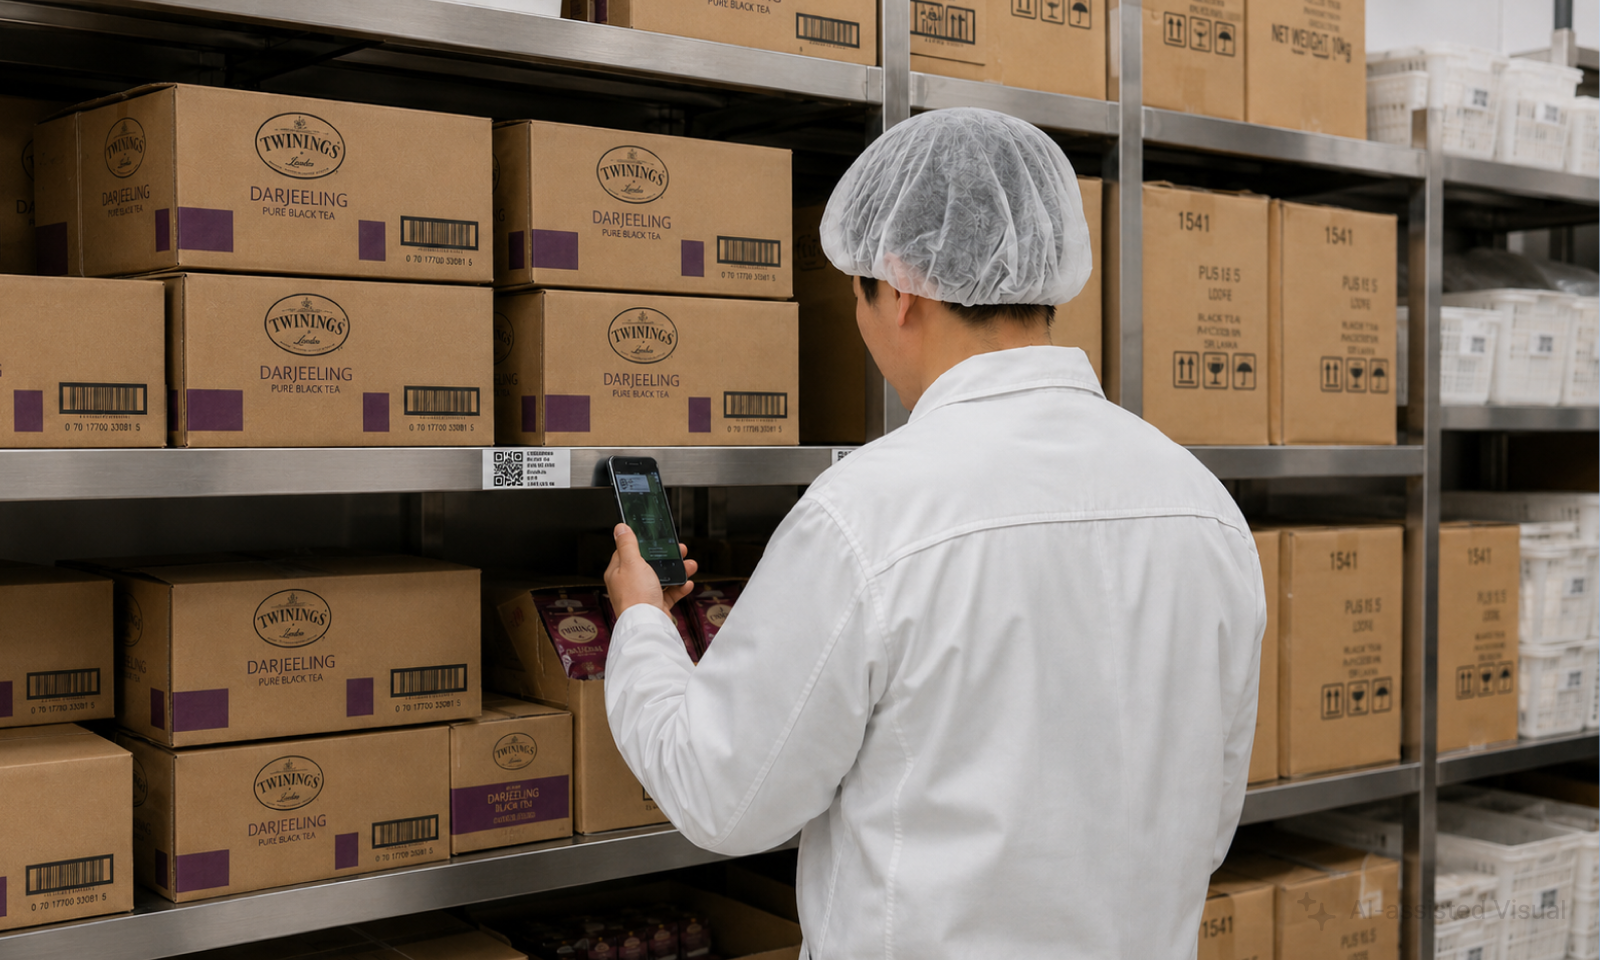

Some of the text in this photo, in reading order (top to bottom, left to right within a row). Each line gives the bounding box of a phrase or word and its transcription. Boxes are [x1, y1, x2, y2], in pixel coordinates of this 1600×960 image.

[730, 1, 754, 12] BLACK
[757, 3, 771, 14] TEA
[1272, 23, 1289, 44] NET
[1292, 28, 1328, 52] WEIGHT
[259, 133, 341, 159] TWININGS
[600, 164, 665, 187] TWININGS
[102, 184, 150, 206] DARJEELING
[250, 186, 348, 208] DARJEELING
[262, 207, 336, 220] PURE BLACK TEA
[592, 210, 672, 230] DARJEELING
[1178, 211, 1209, 232] 1541
[602, 228, 661, 240] PURE BLACK TEA
[1325, 226, 1352, 246] 1541
[269, 313, 346, 336] TWININGS
[611, 325, 675, 346] TWININGS
[260, 365, 353, 383] DARJEELING
[603, 372, 680, 388] DARJEELING
[271, 384, 341, 394] PURE BLACK TEA
[612, 389, 669, 399] PURE BLACK TEA
[64, 422, 70, 431] 0
[74, 422, 82, 431] 70
[86, 422, 108, 431] 17700
[1330, 550, 1357, 571] 1541
[1467, 547, 1491, 565] 1541
[257, 608, 327, 629] TWININGS
[247, 655, 335, 675] DARJEELING
[258, 673, 324, 686] PURE BLACK TEA
[257, 773, 320, 794] TWININGS
[487, 788, 540, 804] DARJEELING
[248, 814, 327, 837] DARJEELING
[258, 837, 277, 847] PURE
[303, 832, 316, 840] TEA
[31, 903, 36, 911] 0
[40, 902, 49, 910] 70
[52, 898, 74, 908] 17700
[102, 893, 106, 901] 5
[1203, 915, 1233, 939] 1541
